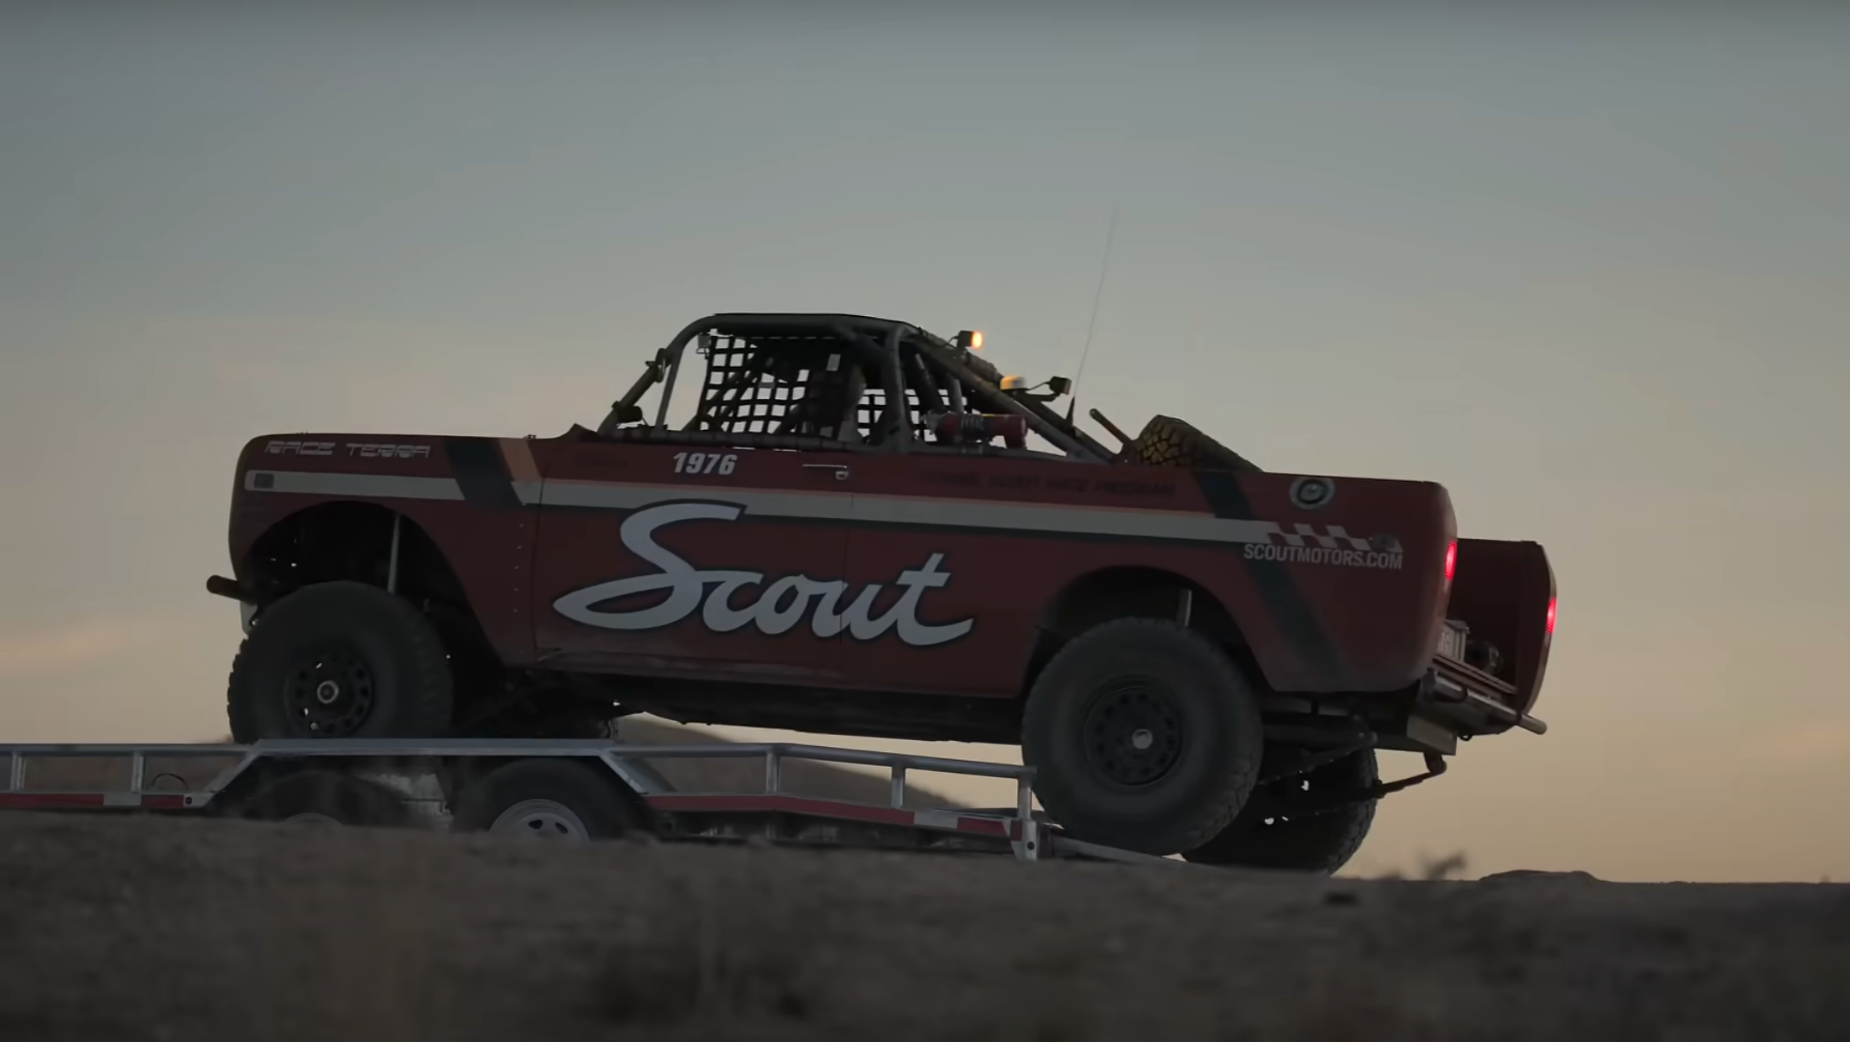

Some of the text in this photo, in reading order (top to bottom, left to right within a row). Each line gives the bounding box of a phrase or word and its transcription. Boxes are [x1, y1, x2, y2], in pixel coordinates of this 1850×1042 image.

[264, 440, 431, 459] RACE TERRA
[672, 451, 738, 476] 1976
[1242, 542, 1404, 570] SCOUTMOTORS.COM
[551, 501, 976, 647] Scout
